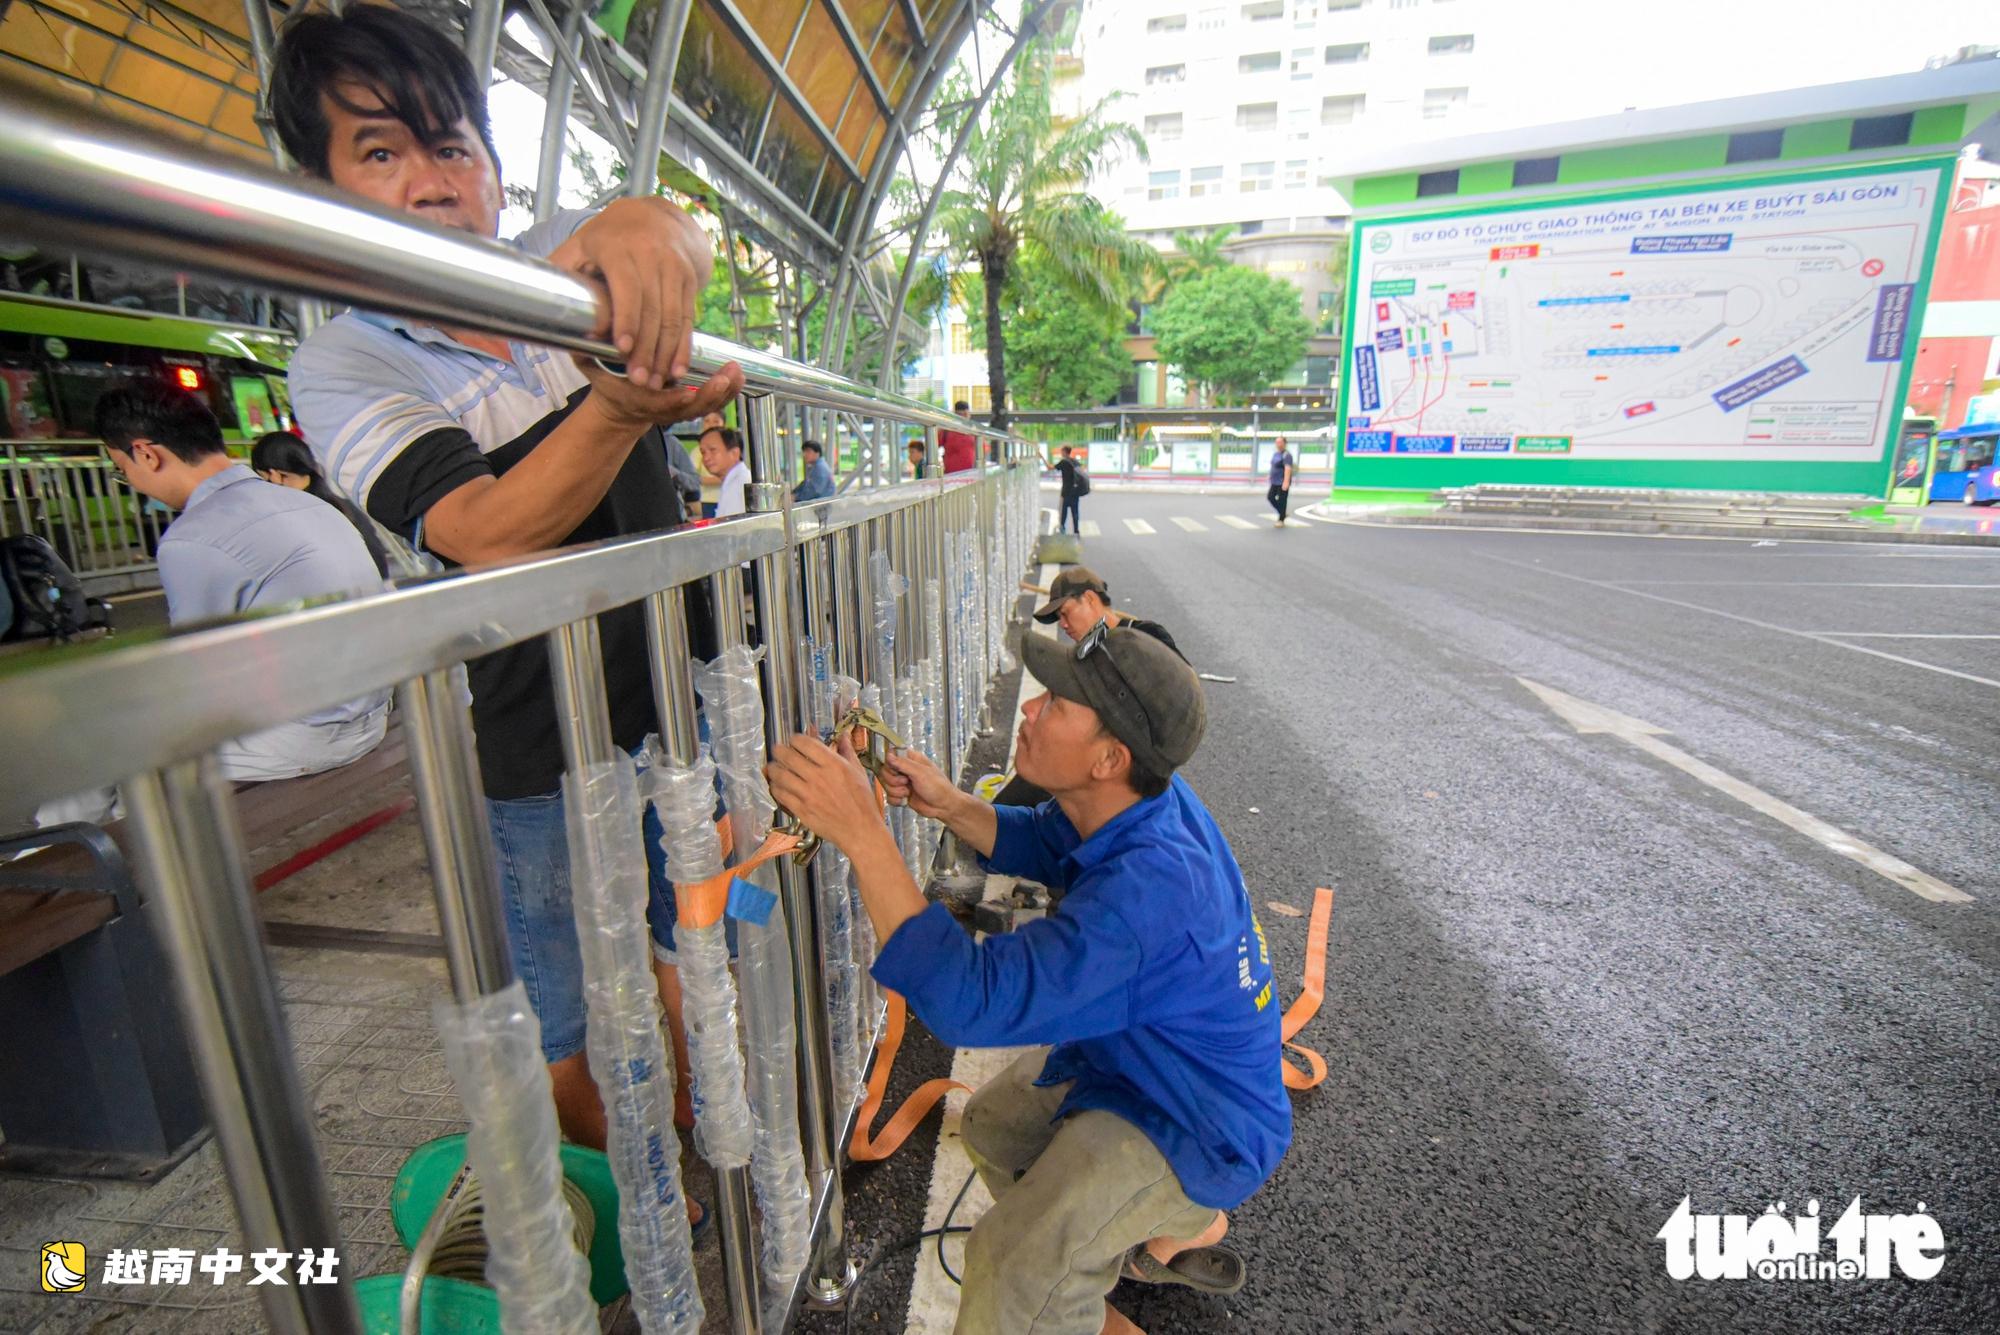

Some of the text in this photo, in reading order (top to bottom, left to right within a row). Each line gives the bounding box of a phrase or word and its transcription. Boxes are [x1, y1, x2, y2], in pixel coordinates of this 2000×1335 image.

[1538, 217, 1578, 230] GIAO
[1585, 210, 1643, 226] THÔNG
[1725, 199, 1750, 212] XE
